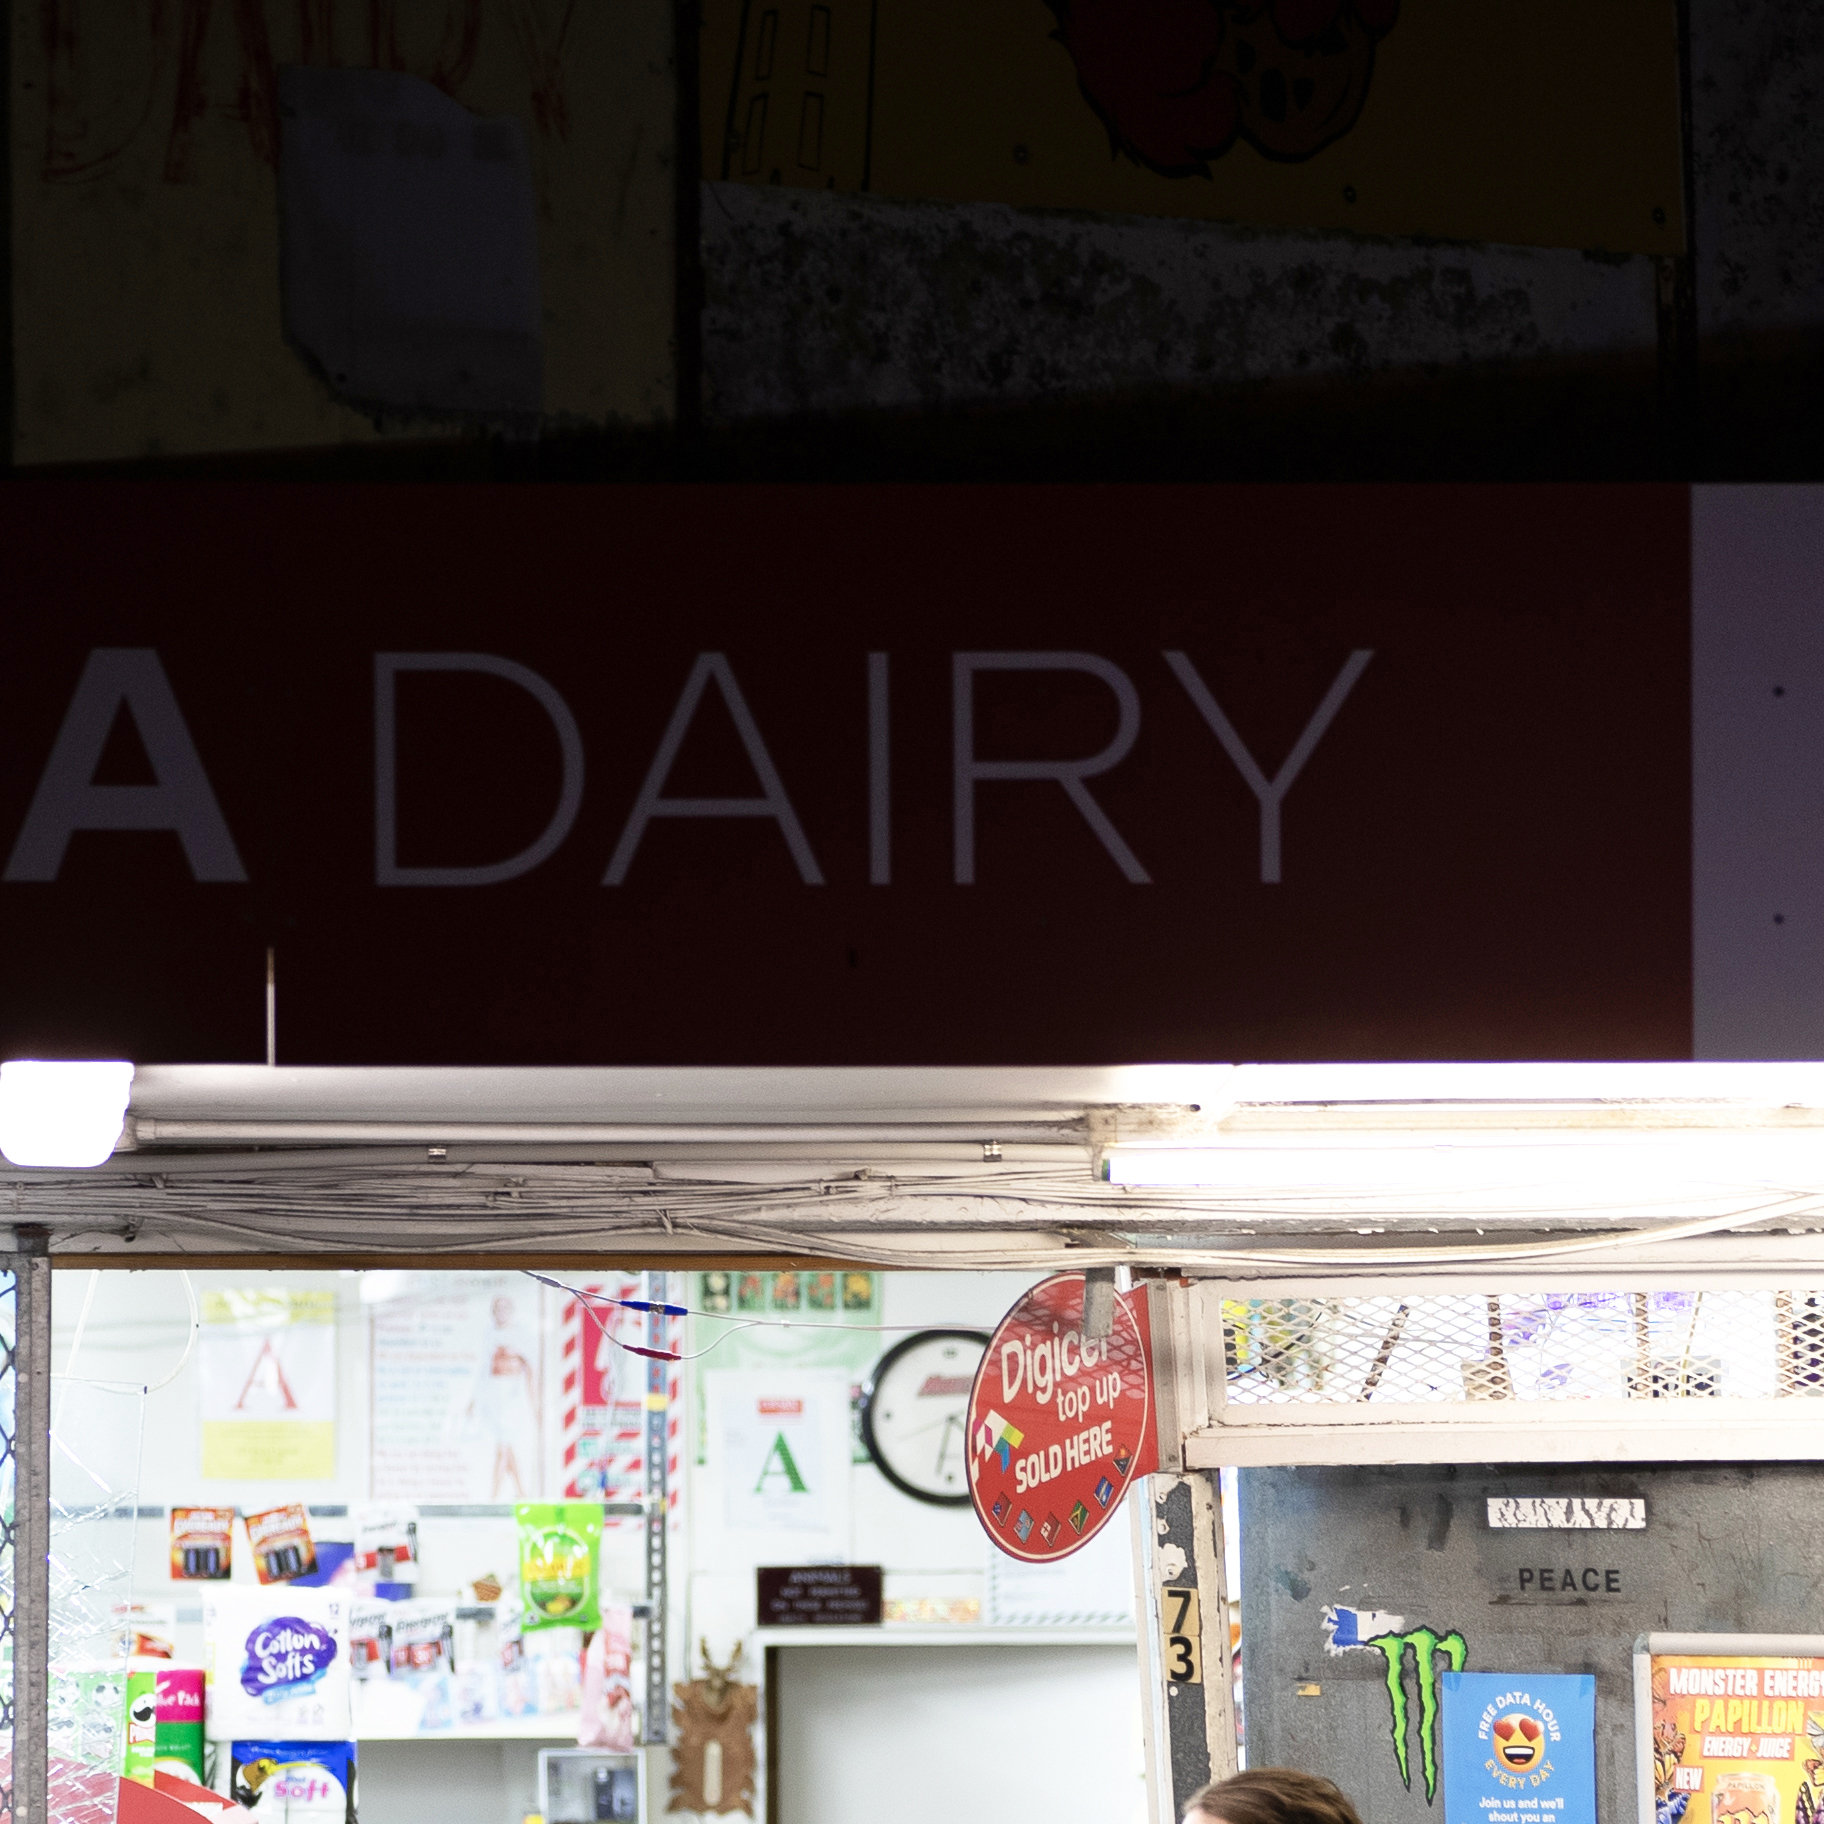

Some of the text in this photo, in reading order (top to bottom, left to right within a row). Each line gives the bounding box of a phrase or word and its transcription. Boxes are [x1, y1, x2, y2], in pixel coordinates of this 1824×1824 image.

[372, 647, 1377, 890] DAIRY
[1056, 1371, 1122, 1423] top up
[753, 1430, 810, 1493] A
[1014, 1419, 1114, 1494] SOLD HERE
[1518, 1567, 1622, 1594] PEACE
[254, 1626, 321, 1659] Cotton
[256, 1650, 316, 1684] Softs
[1669, 1668, 1759, 1697] MONSTER
[1477, 1691, 1562, 1743] FREE DATA HOUR
[1693, 1698, 1805, 1736] PAPILLON
[1702, 1736, 1752, 1758] ENERGY
[1756, 1737, 1792, 1759] JUICE
[274, 1778, 330, 1802] Soft
[1484, 1758, 1555, 1790] EVERY DAY
[1676, 1767, 1703, 1791] NEW
[1479, 1797, 1501, 1810] Join
[1503, 1799, 1517, 1810] us
[1518, 1797, 1538, 1810] and
[1488, 1810, 1556, 1824] shout you an
